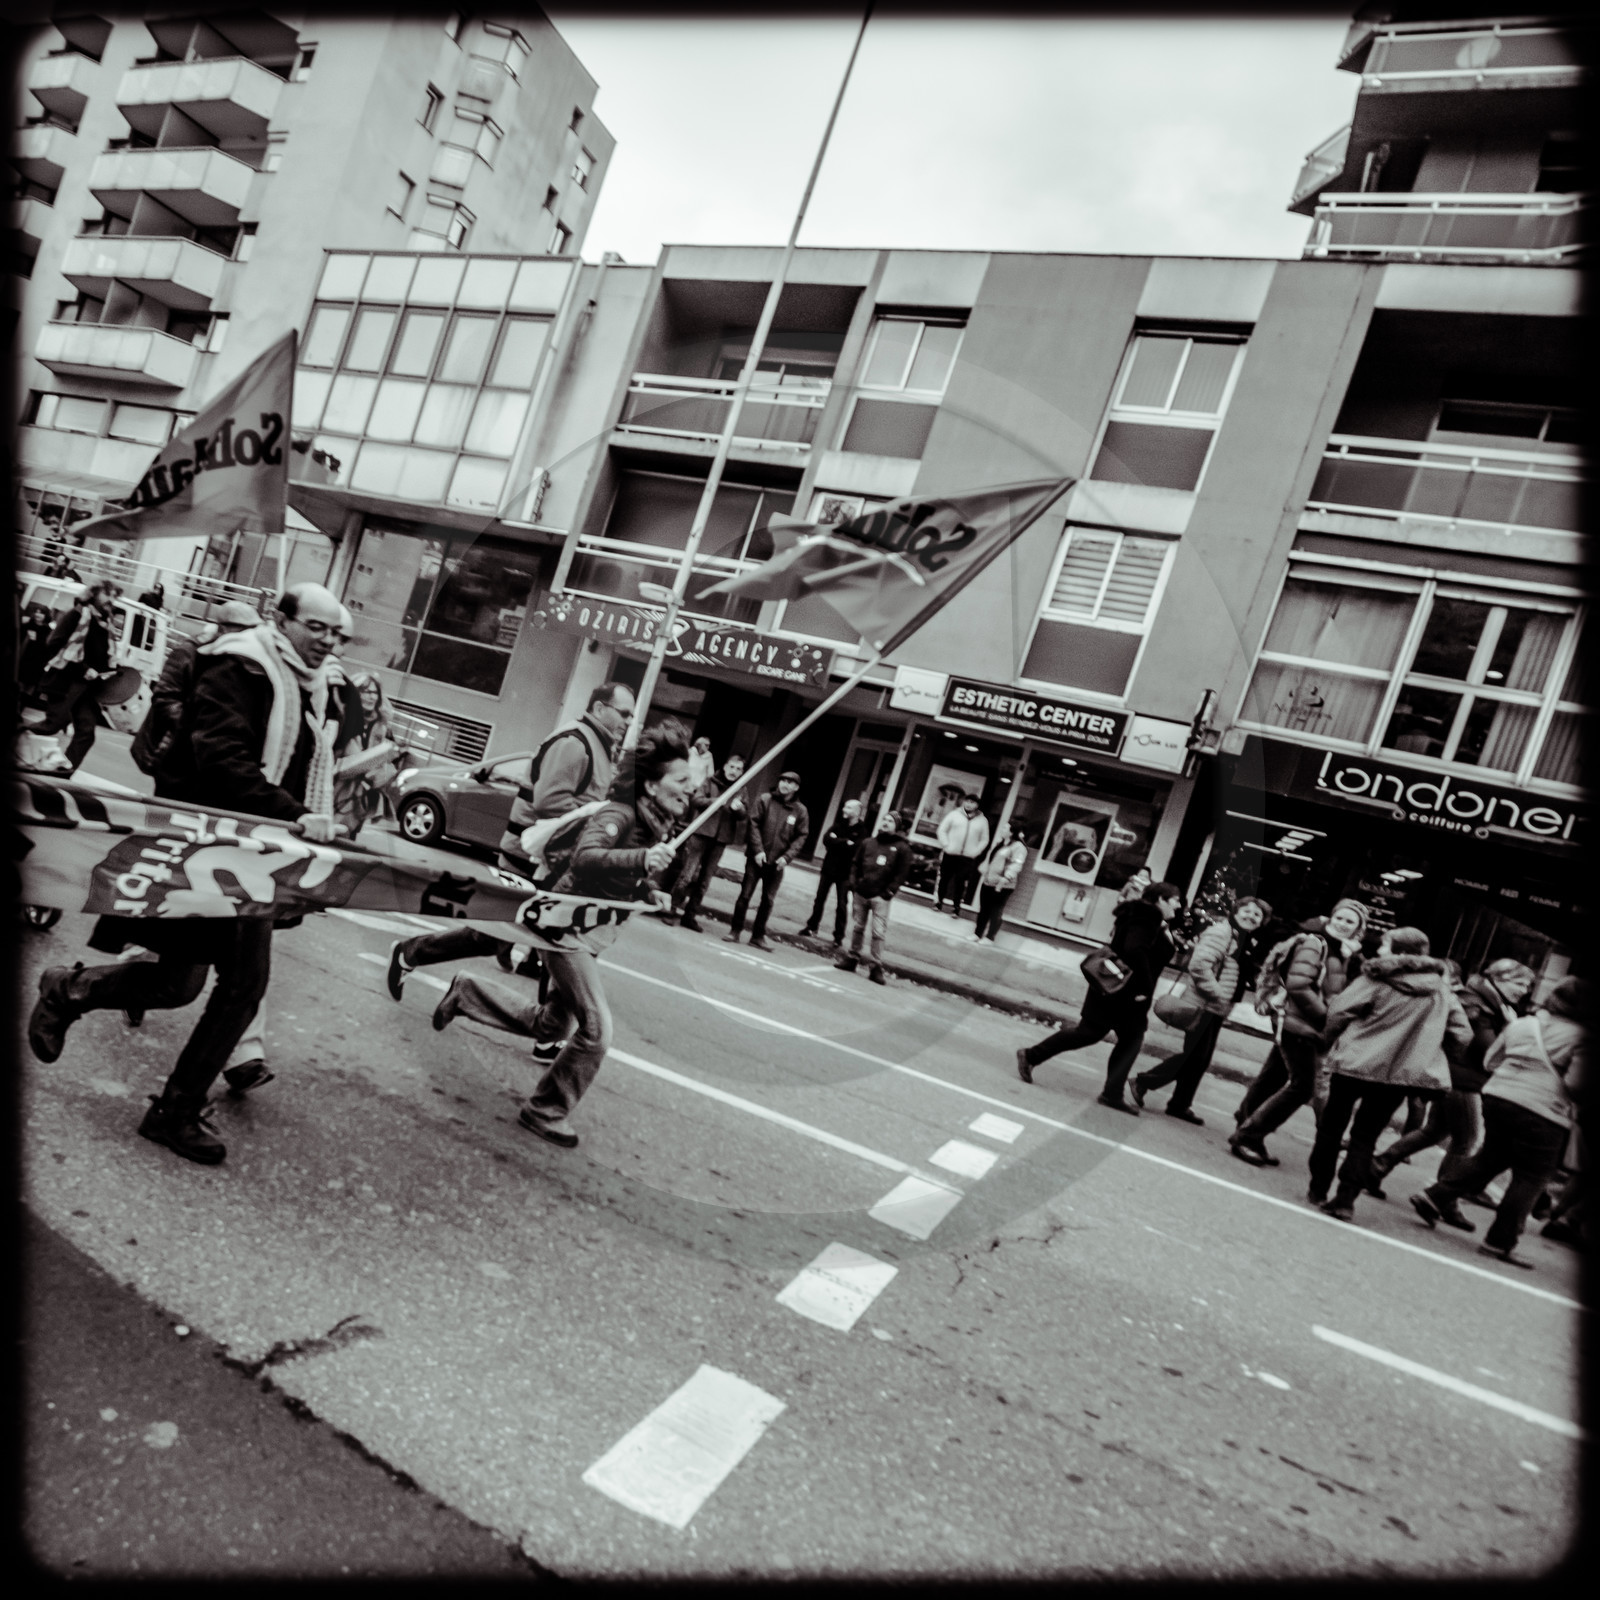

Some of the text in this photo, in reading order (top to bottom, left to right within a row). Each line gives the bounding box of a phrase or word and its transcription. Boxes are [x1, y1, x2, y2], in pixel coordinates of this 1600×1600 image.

[578, 607, 779, 665] OZIRIS AGENCY
[952, 686, 1116, 736] ESTHETIC CENTER
[1409, 811, 1472, 833] coiffure
